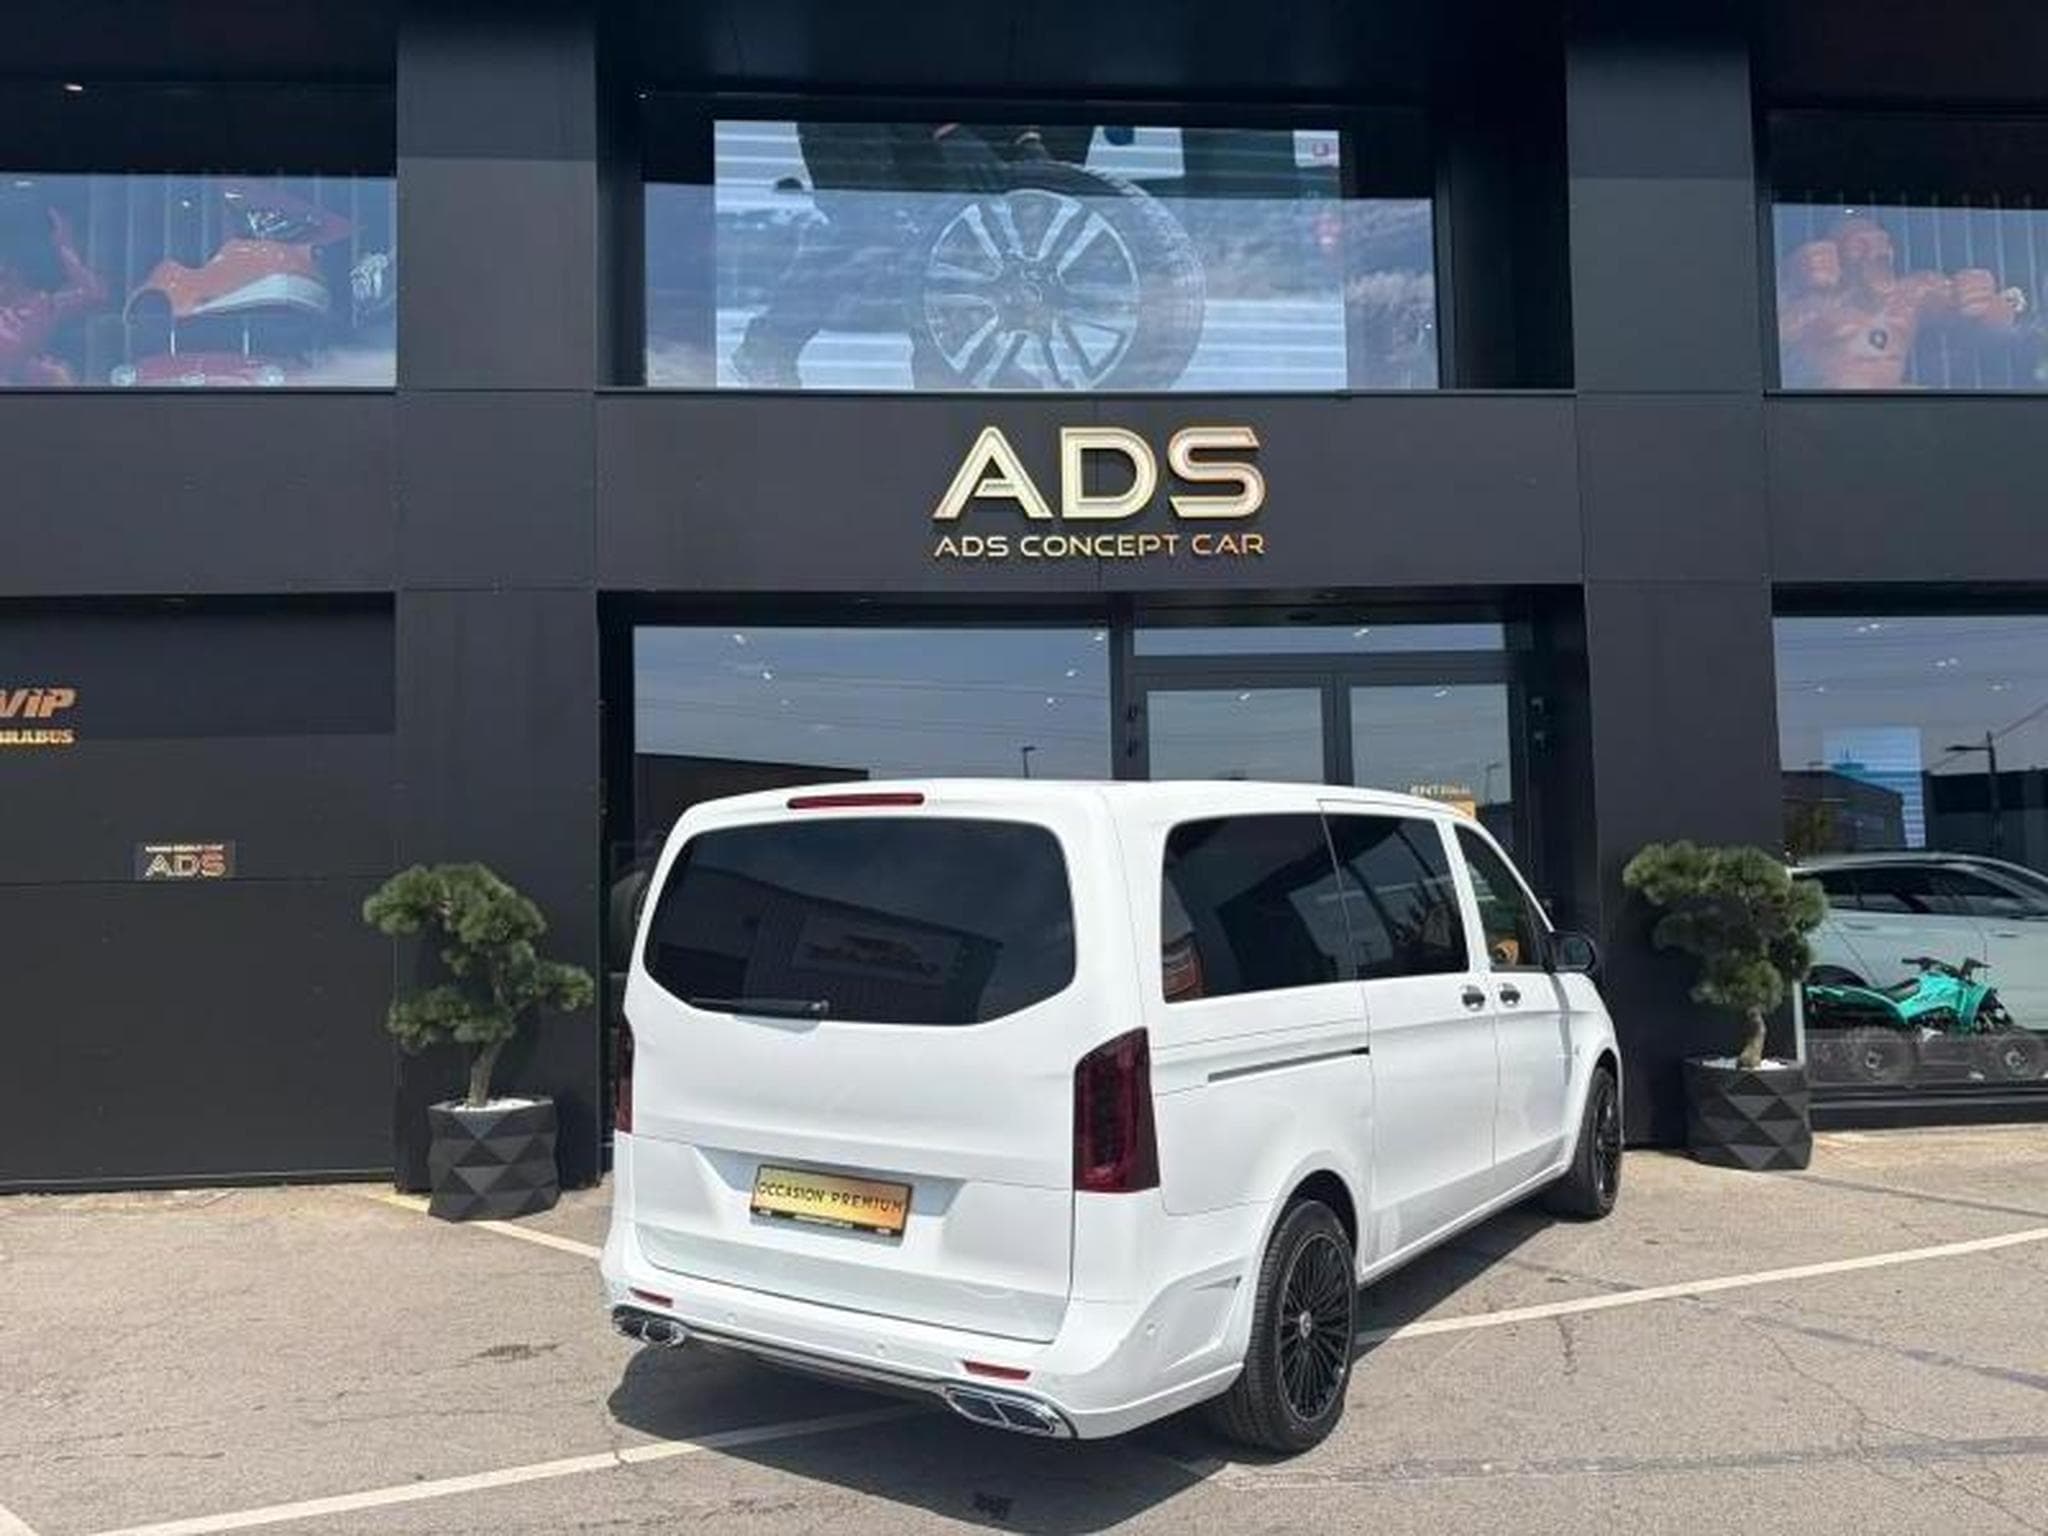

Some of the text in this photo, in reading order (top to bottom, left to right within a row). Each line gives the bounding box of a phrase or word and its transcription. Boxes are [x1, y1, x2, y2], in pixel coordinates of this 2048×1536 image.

[933, 426, 1266, 519] ADS
[933, 533, 1266, 557] ADS CONCEPT CAR
[145, 853, 227, 877] ADS
[758, 1181, 904, 1213] OCCASION PREMIUM
